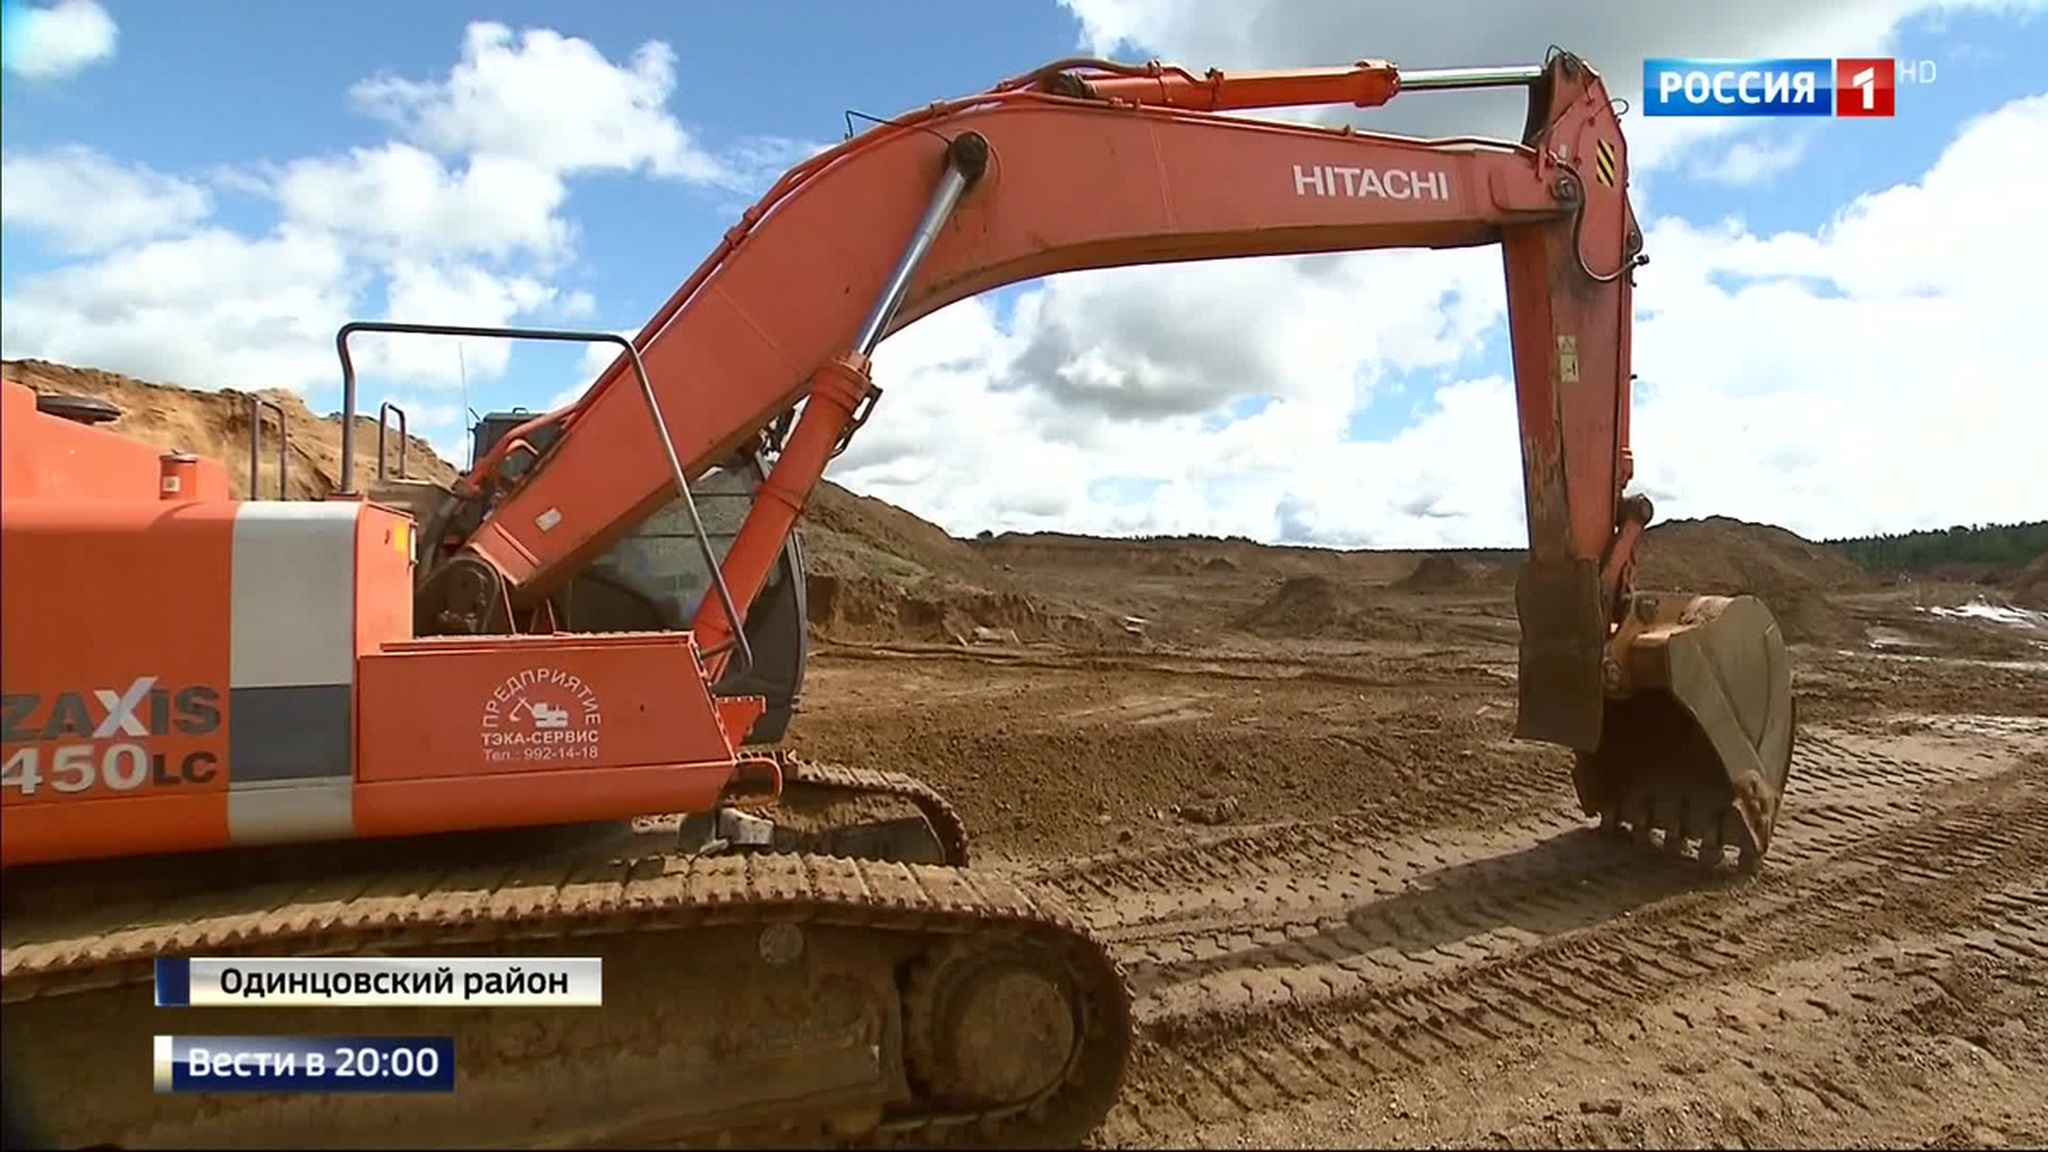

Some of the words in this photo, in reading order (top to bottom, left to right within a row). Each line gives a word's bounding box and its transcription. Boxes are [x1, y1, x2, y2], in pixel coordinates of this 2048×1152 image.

[1292, 164, 1450, 200] HITACHI
[0, 676, 222, 743] ZAXIS
[482, 668, 601, 728] ПРЕДПРИЯТИЕ
[481, 730, 599, 747] ТЭКА-СЕРВИС
[524, 745, 599, 761] 992-14-18
